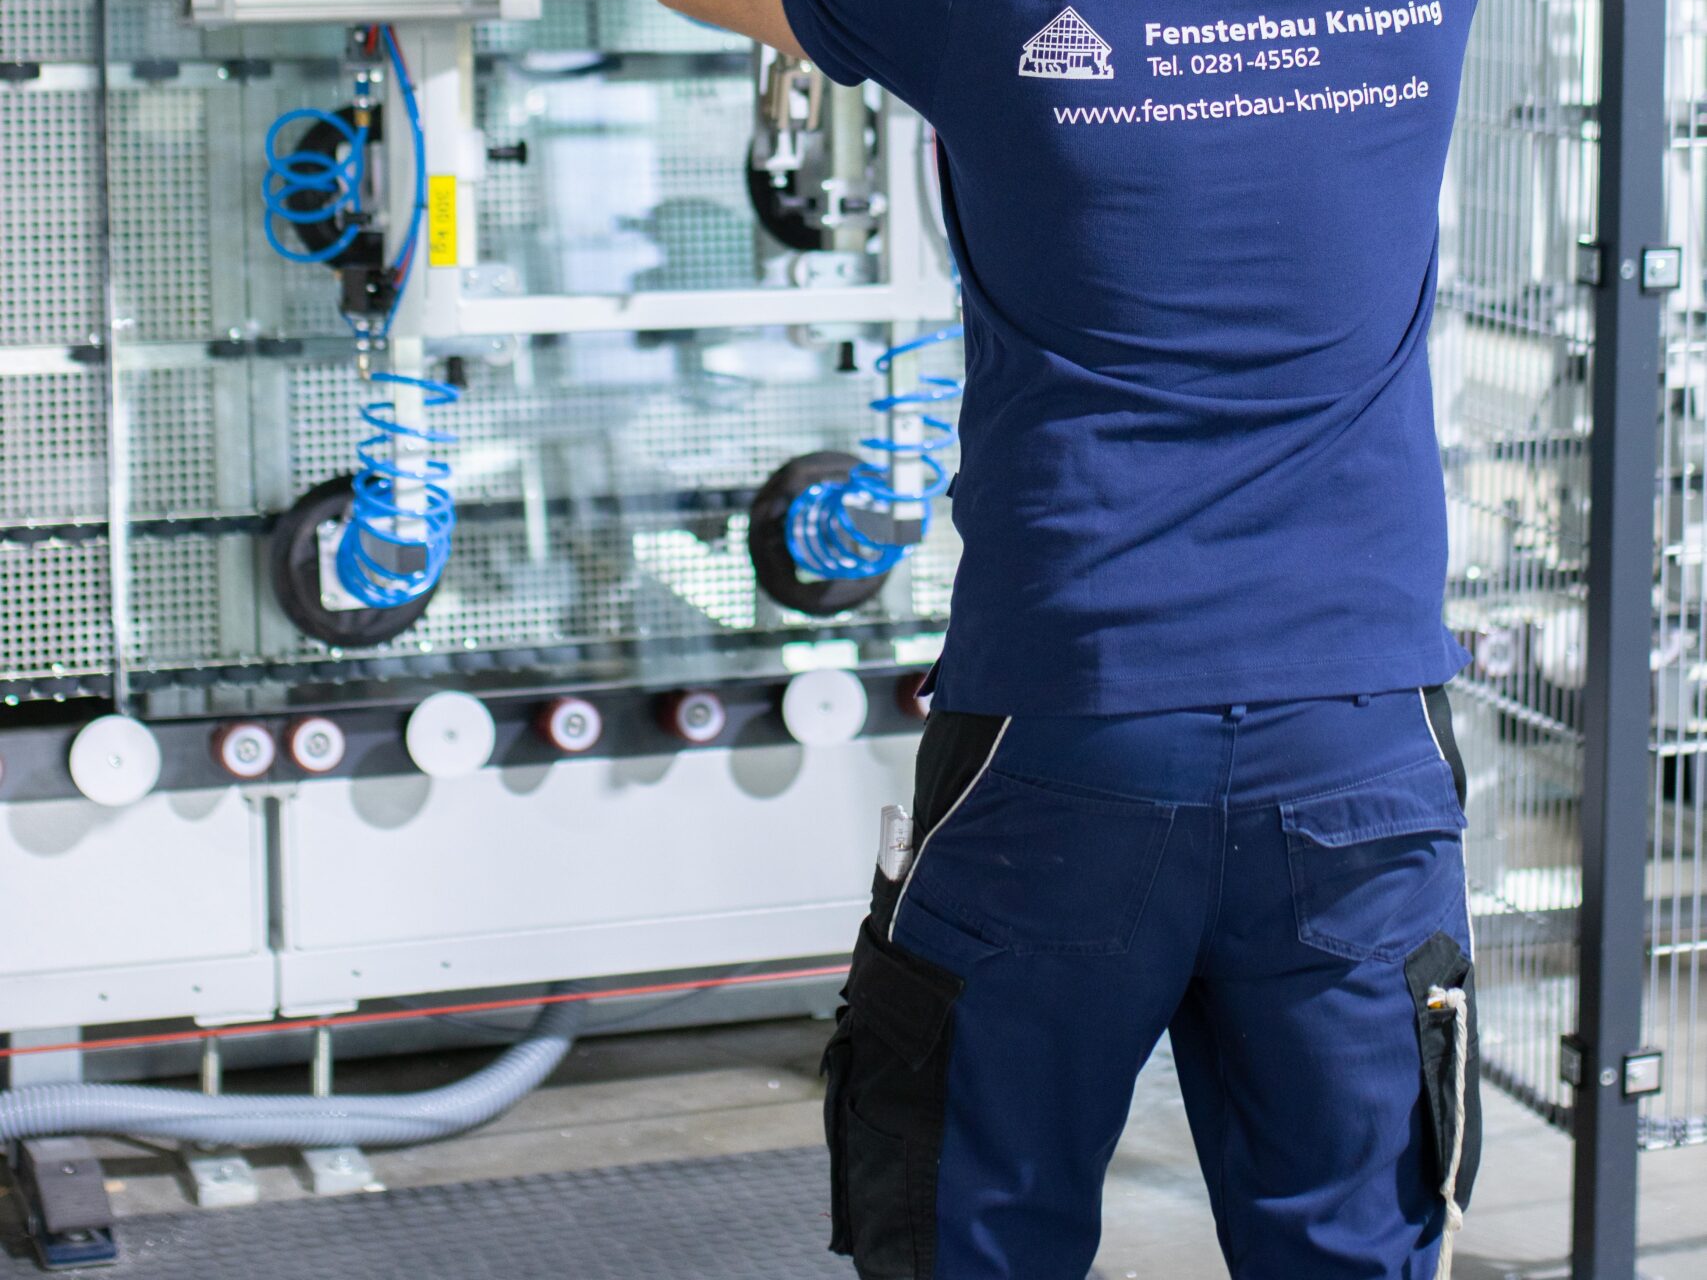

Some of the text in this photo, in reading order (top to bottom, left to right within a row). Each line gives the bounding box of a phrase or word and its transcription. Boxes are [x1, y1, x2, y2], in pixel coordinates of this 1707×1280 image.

[1144, 0, 1444, 46] Fensterbau Knipping
[1146, 46, 1321, 77] Tel. 0281-45562
[1053, 76, 1430, 125] www.fensterbau-knipping.de
